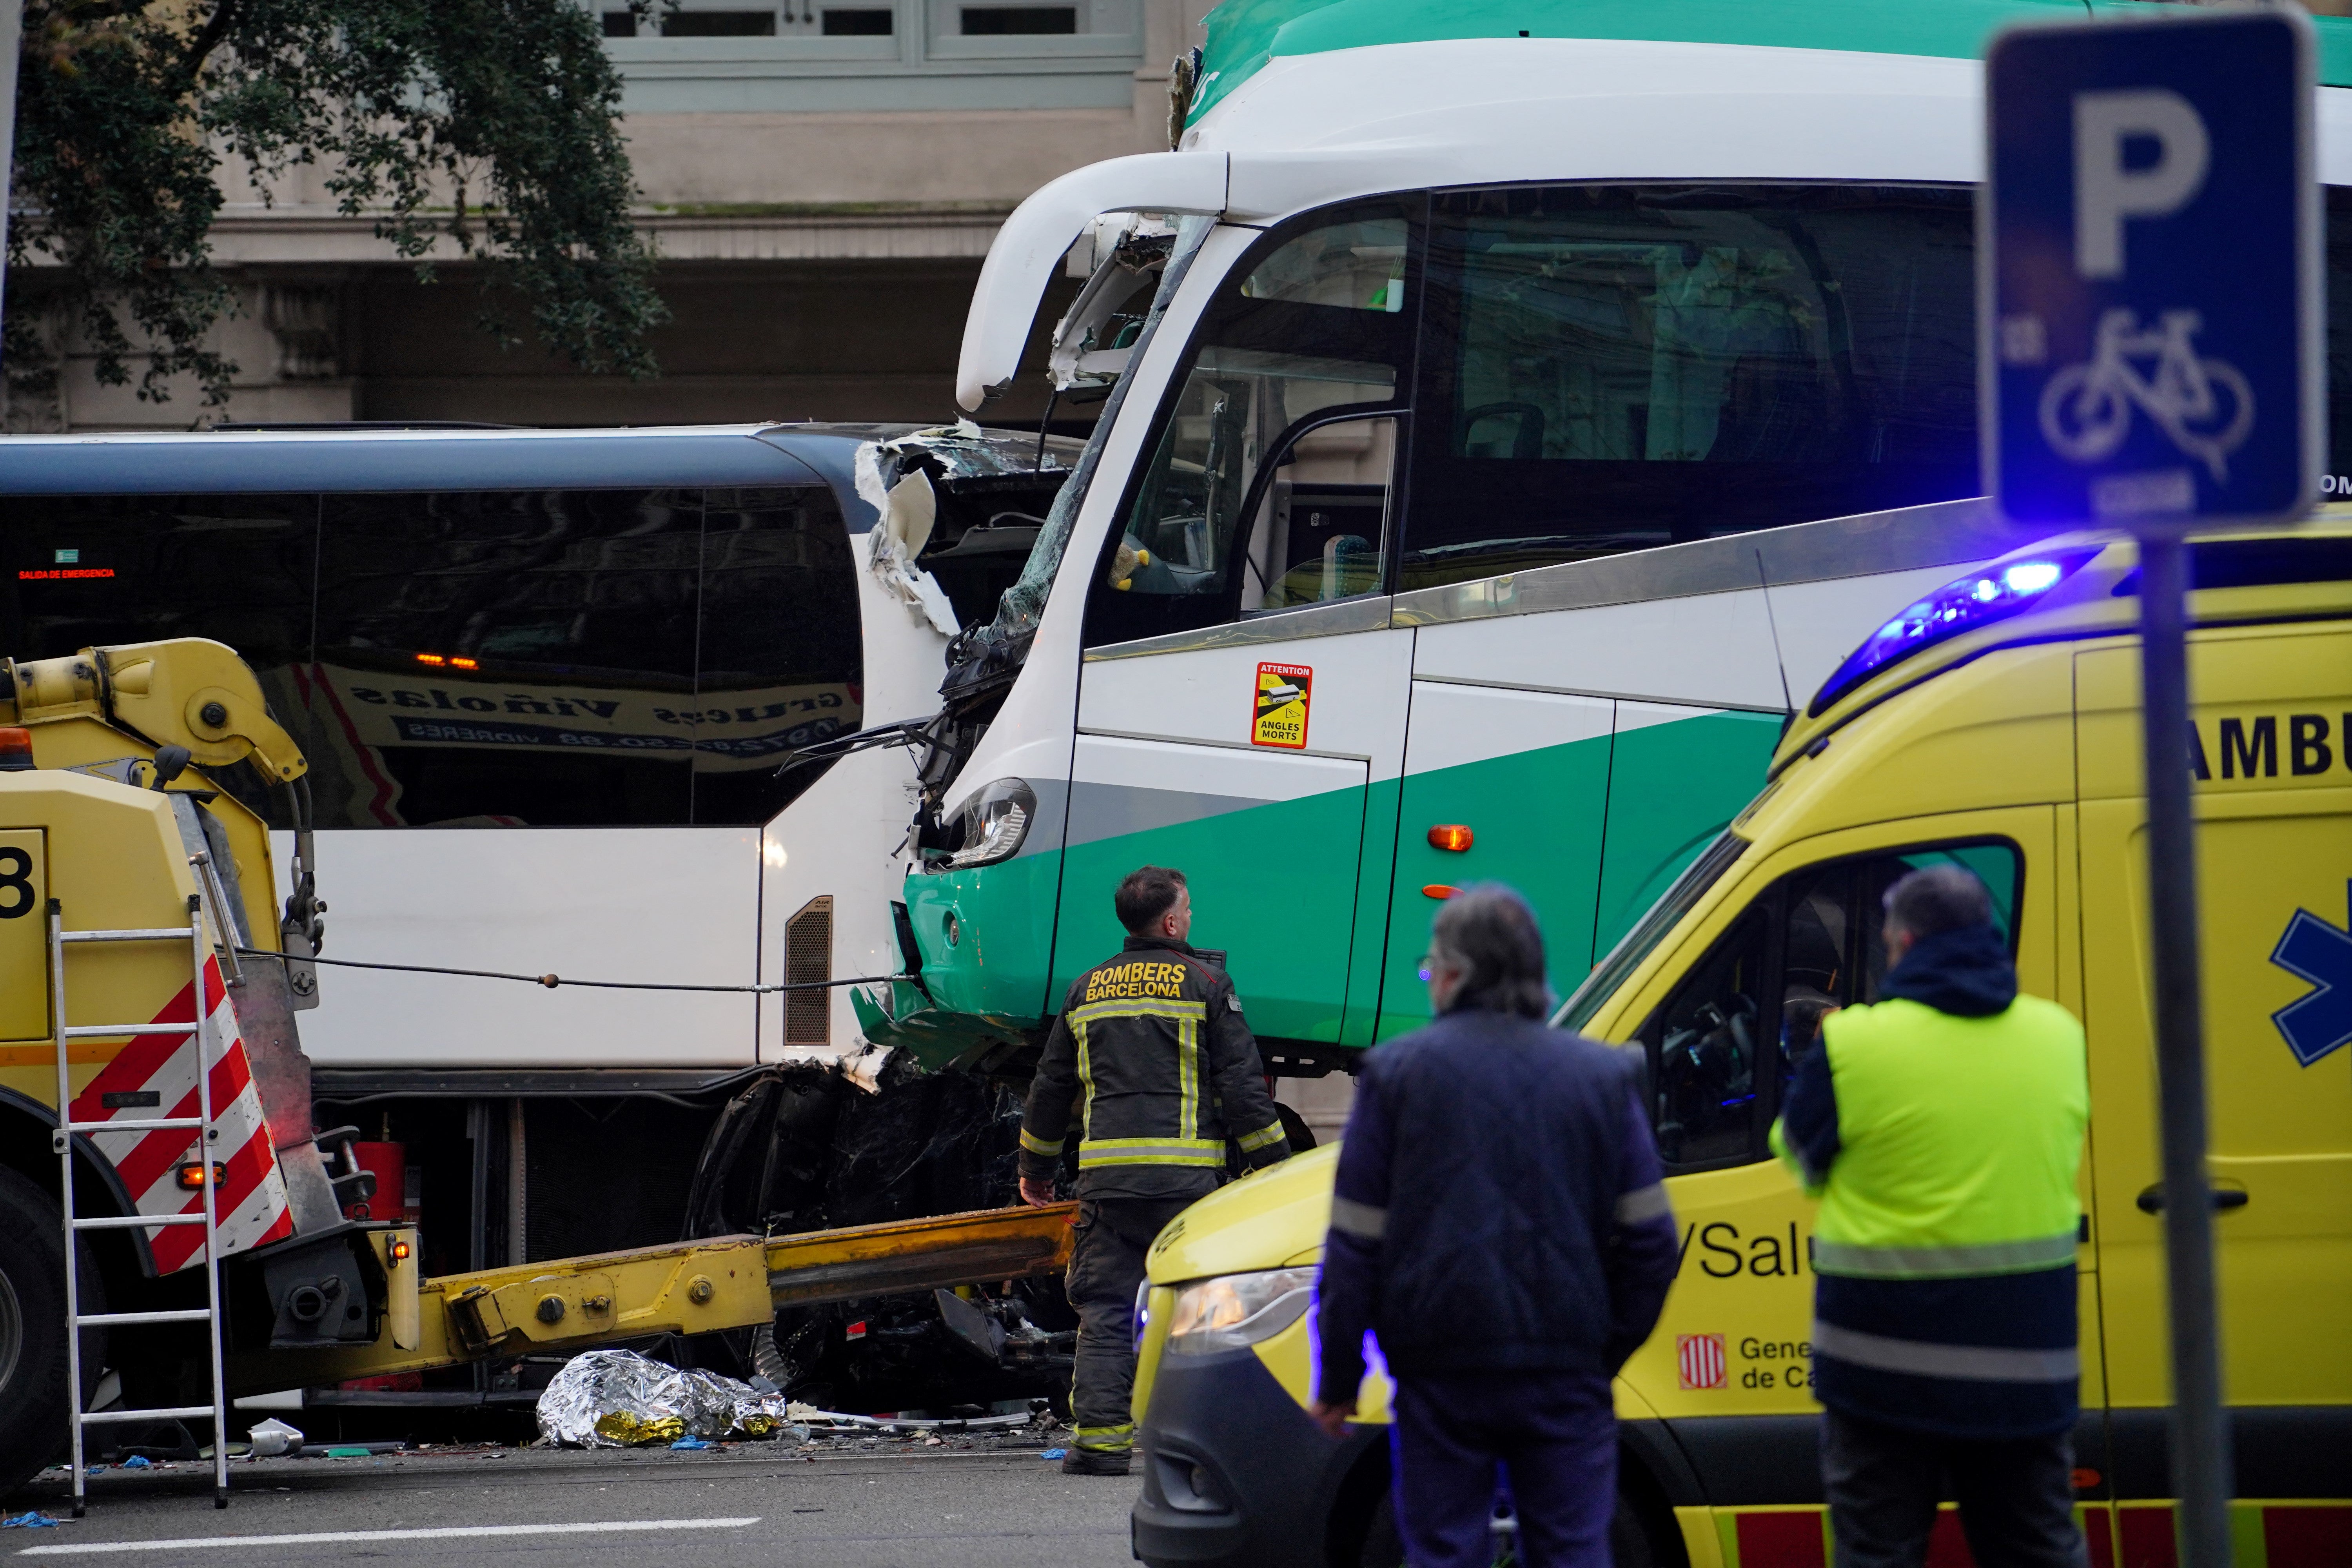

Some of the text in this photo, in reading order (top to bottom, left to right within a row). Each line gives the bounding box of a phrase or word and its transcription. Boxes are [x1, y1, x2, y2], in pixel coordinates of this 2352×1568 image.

[2073, 88, 2210, 278] P
[19, 569, 114, 579] SALIDA DE EMERGENCIA
[1261, 664, 1309, 675] ATTENTION
[1261, 721, 1299, 731] ANGLES
[1263, 730, 1297, 740] MORTS
[1088, 962, 1187, 988] BOMBERS
[1086, 982, 1181, 1001] BARCELONA
[1742, 1368, 1775, 1389] de
